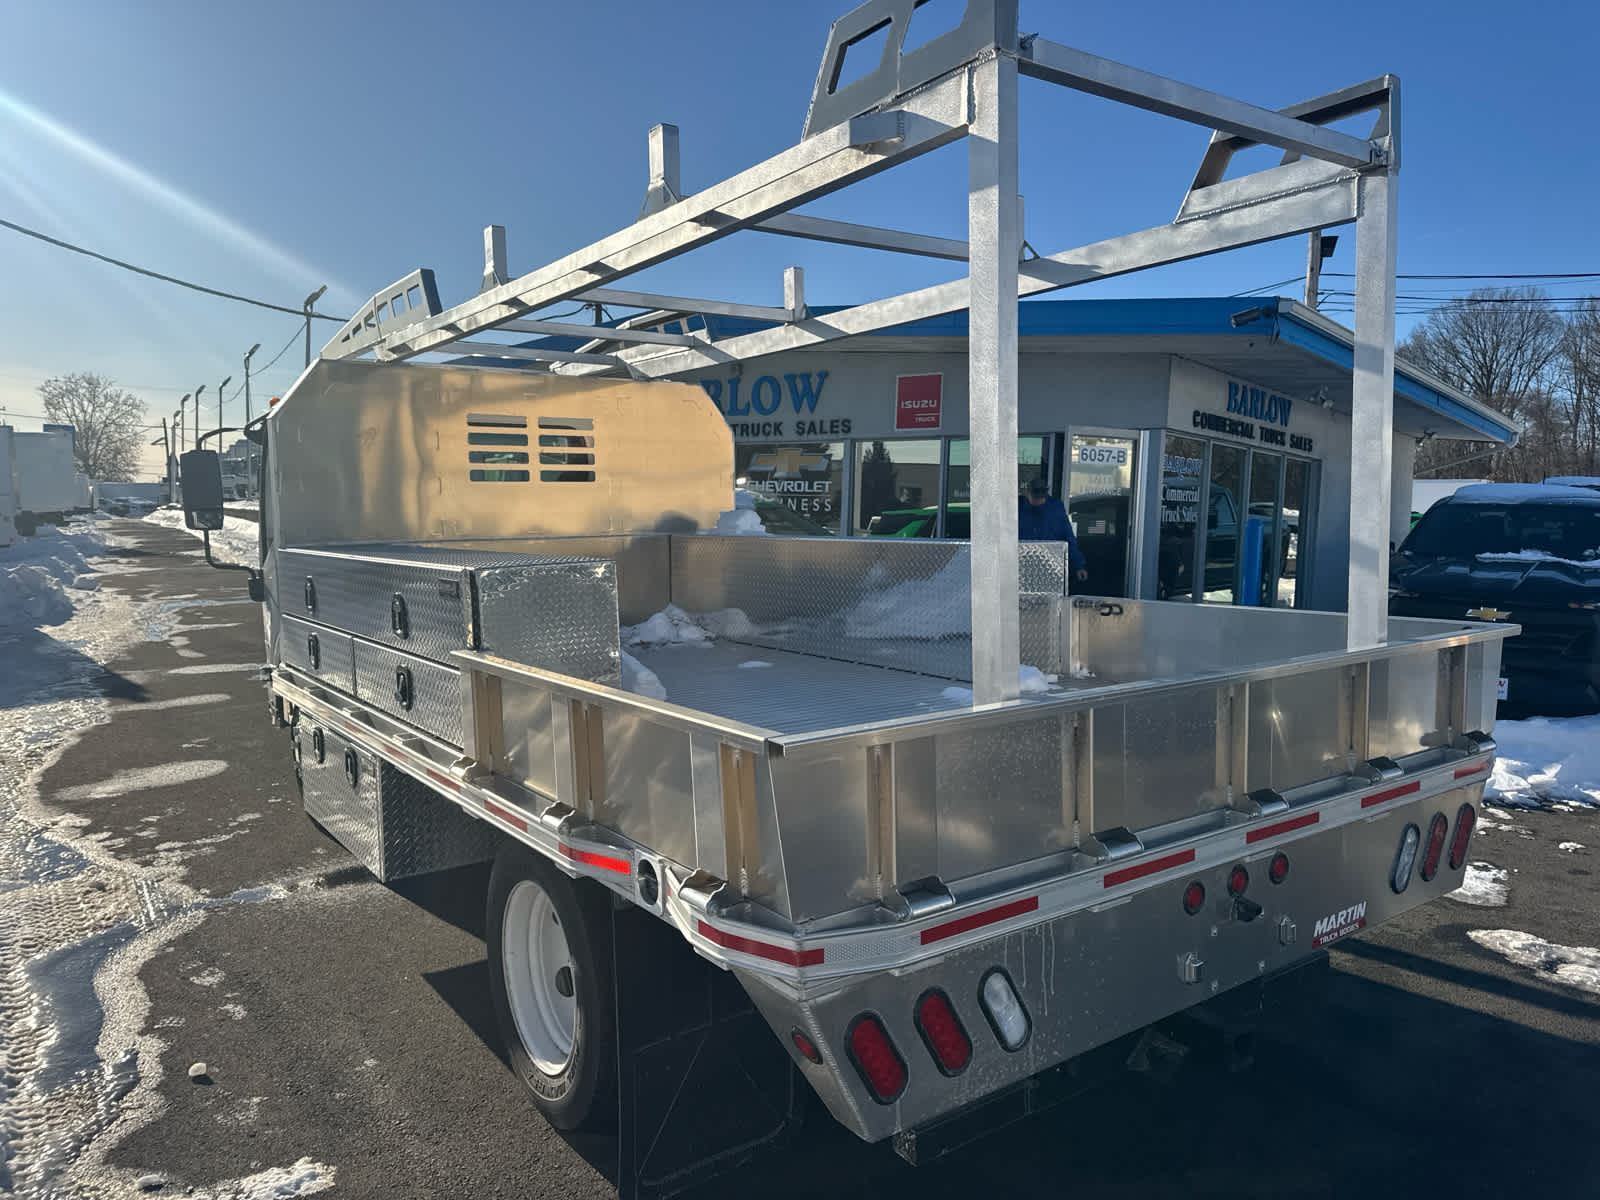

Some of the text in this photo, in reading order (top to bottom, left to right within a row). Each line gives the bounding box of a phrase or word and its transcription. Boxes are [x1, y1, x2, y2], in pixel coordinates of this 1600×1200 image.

[699, 371, 829, 417] RLOW
[901, 399, 937, 409] ISUZU
[1226, 381, 1292, 427] BARLOW
[732, 419, 852, 436] TRUCK SALES
[1192, 410, 1313, 452] COMMERCIAL TRUCK SALES
[1080, 447, 1126, 464] 6057-B
[747, 480, 833, 493] CHEVROLET
[1160, 484, 1200, 502] Commercial
[1160, 505, 1181, 522] Truck
[1313, 900, 1367, 938] MARTIN
[1319, 932, 1338, 945] TRUCK
